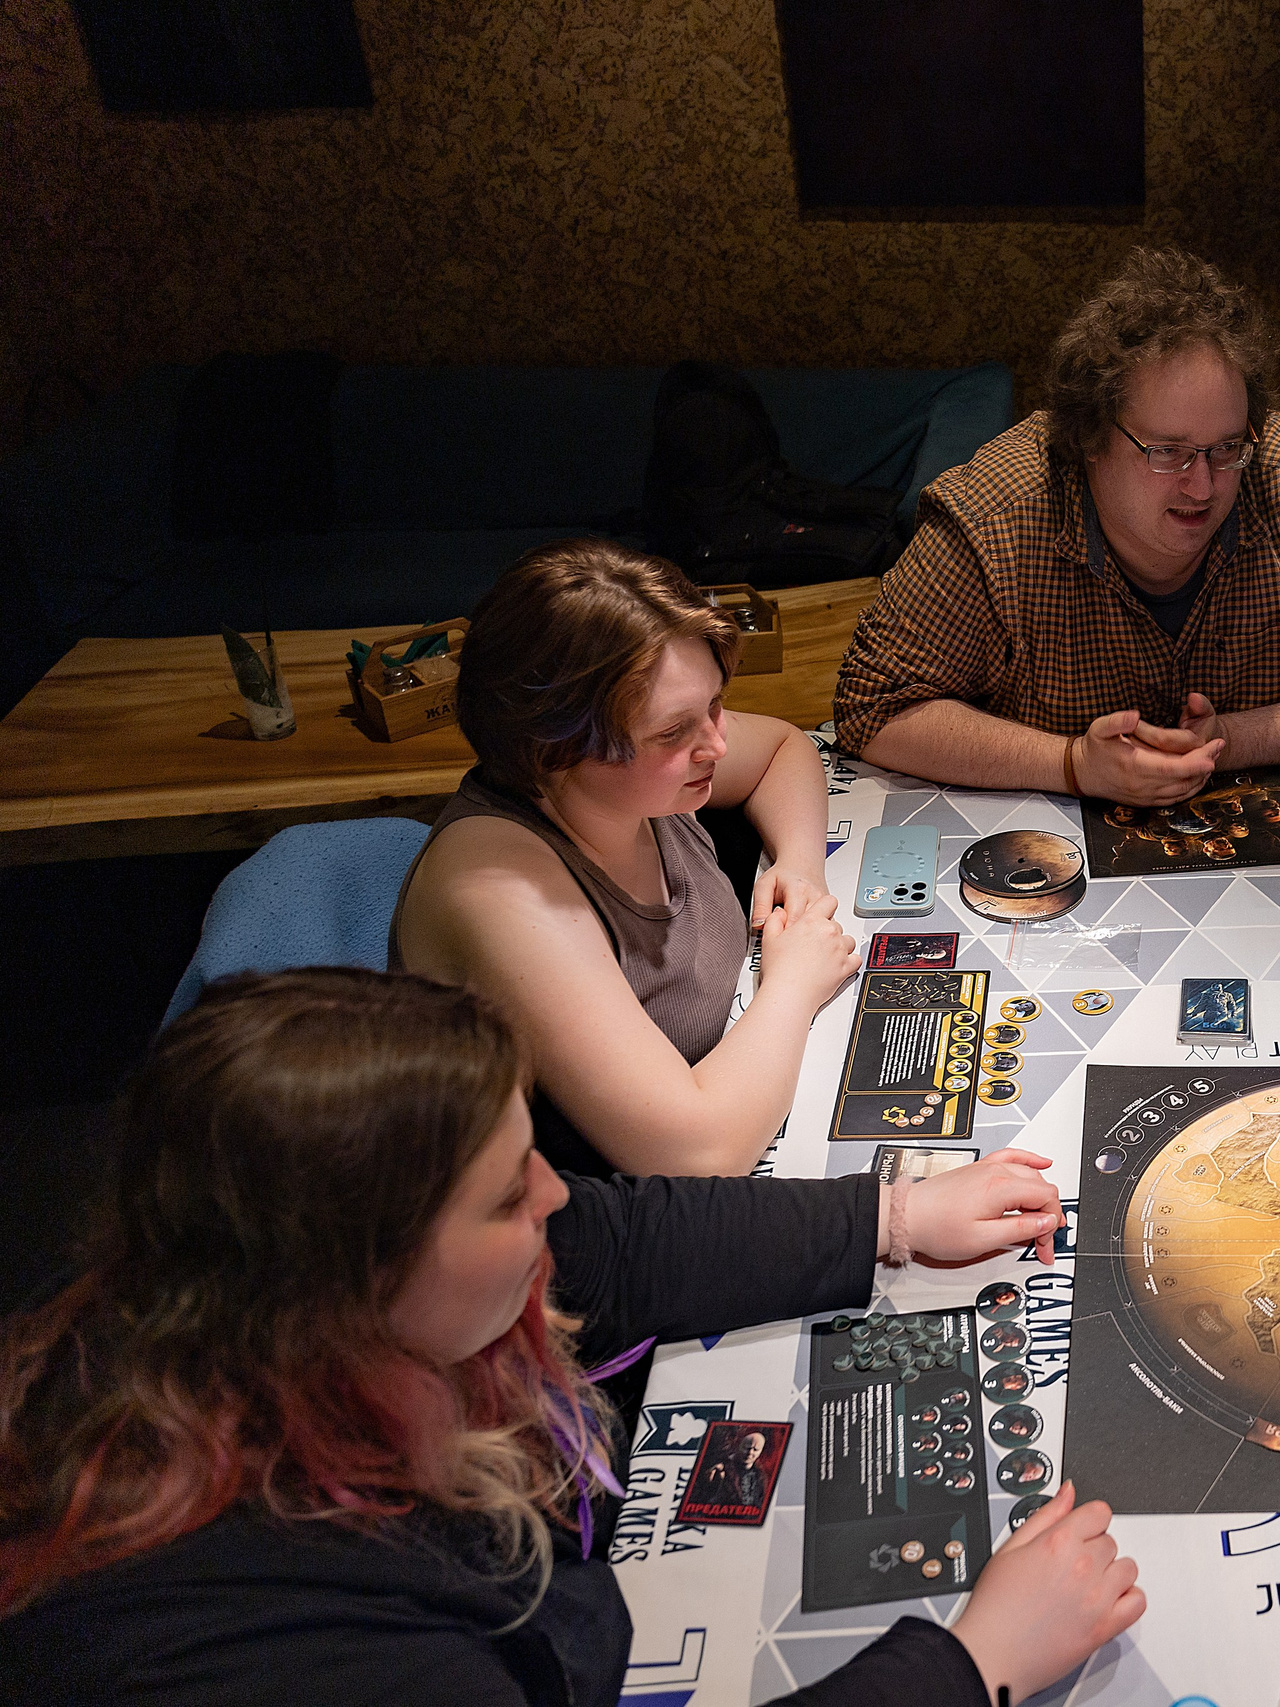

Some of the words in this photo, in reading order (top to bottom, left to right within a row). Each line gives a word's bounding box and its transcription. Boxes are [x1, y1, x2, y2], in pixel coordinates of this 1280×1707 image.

[1195, 1080, 1210, 1093] 5
[927, 1095, 940, 1104] 10
[1168, 1094, 1184, 1107] 4
[1143, 1110, 1159, 1123] 3
[1121, 1129, 1140, 1143] 2
[983, 1337, 995, 1346] 3
[984, 1379, 997, 1388] 3
[1126, 1361, 1183, 1416] АКСОЛОТЛЬ-БАКИ
[991, 1421, 1004, 1430] 4
[1000, 1471, 1014, 1480] 4
[685, 1503, 760, 1516] ПРЕДАТЕЛЬ
[610, 1467, 666, 1565] GAMES
[1012, 1518, 1026, 1528] 5
[904, 1545, 921, 1557] 10
[949, 1545, 961, 1554] 2
